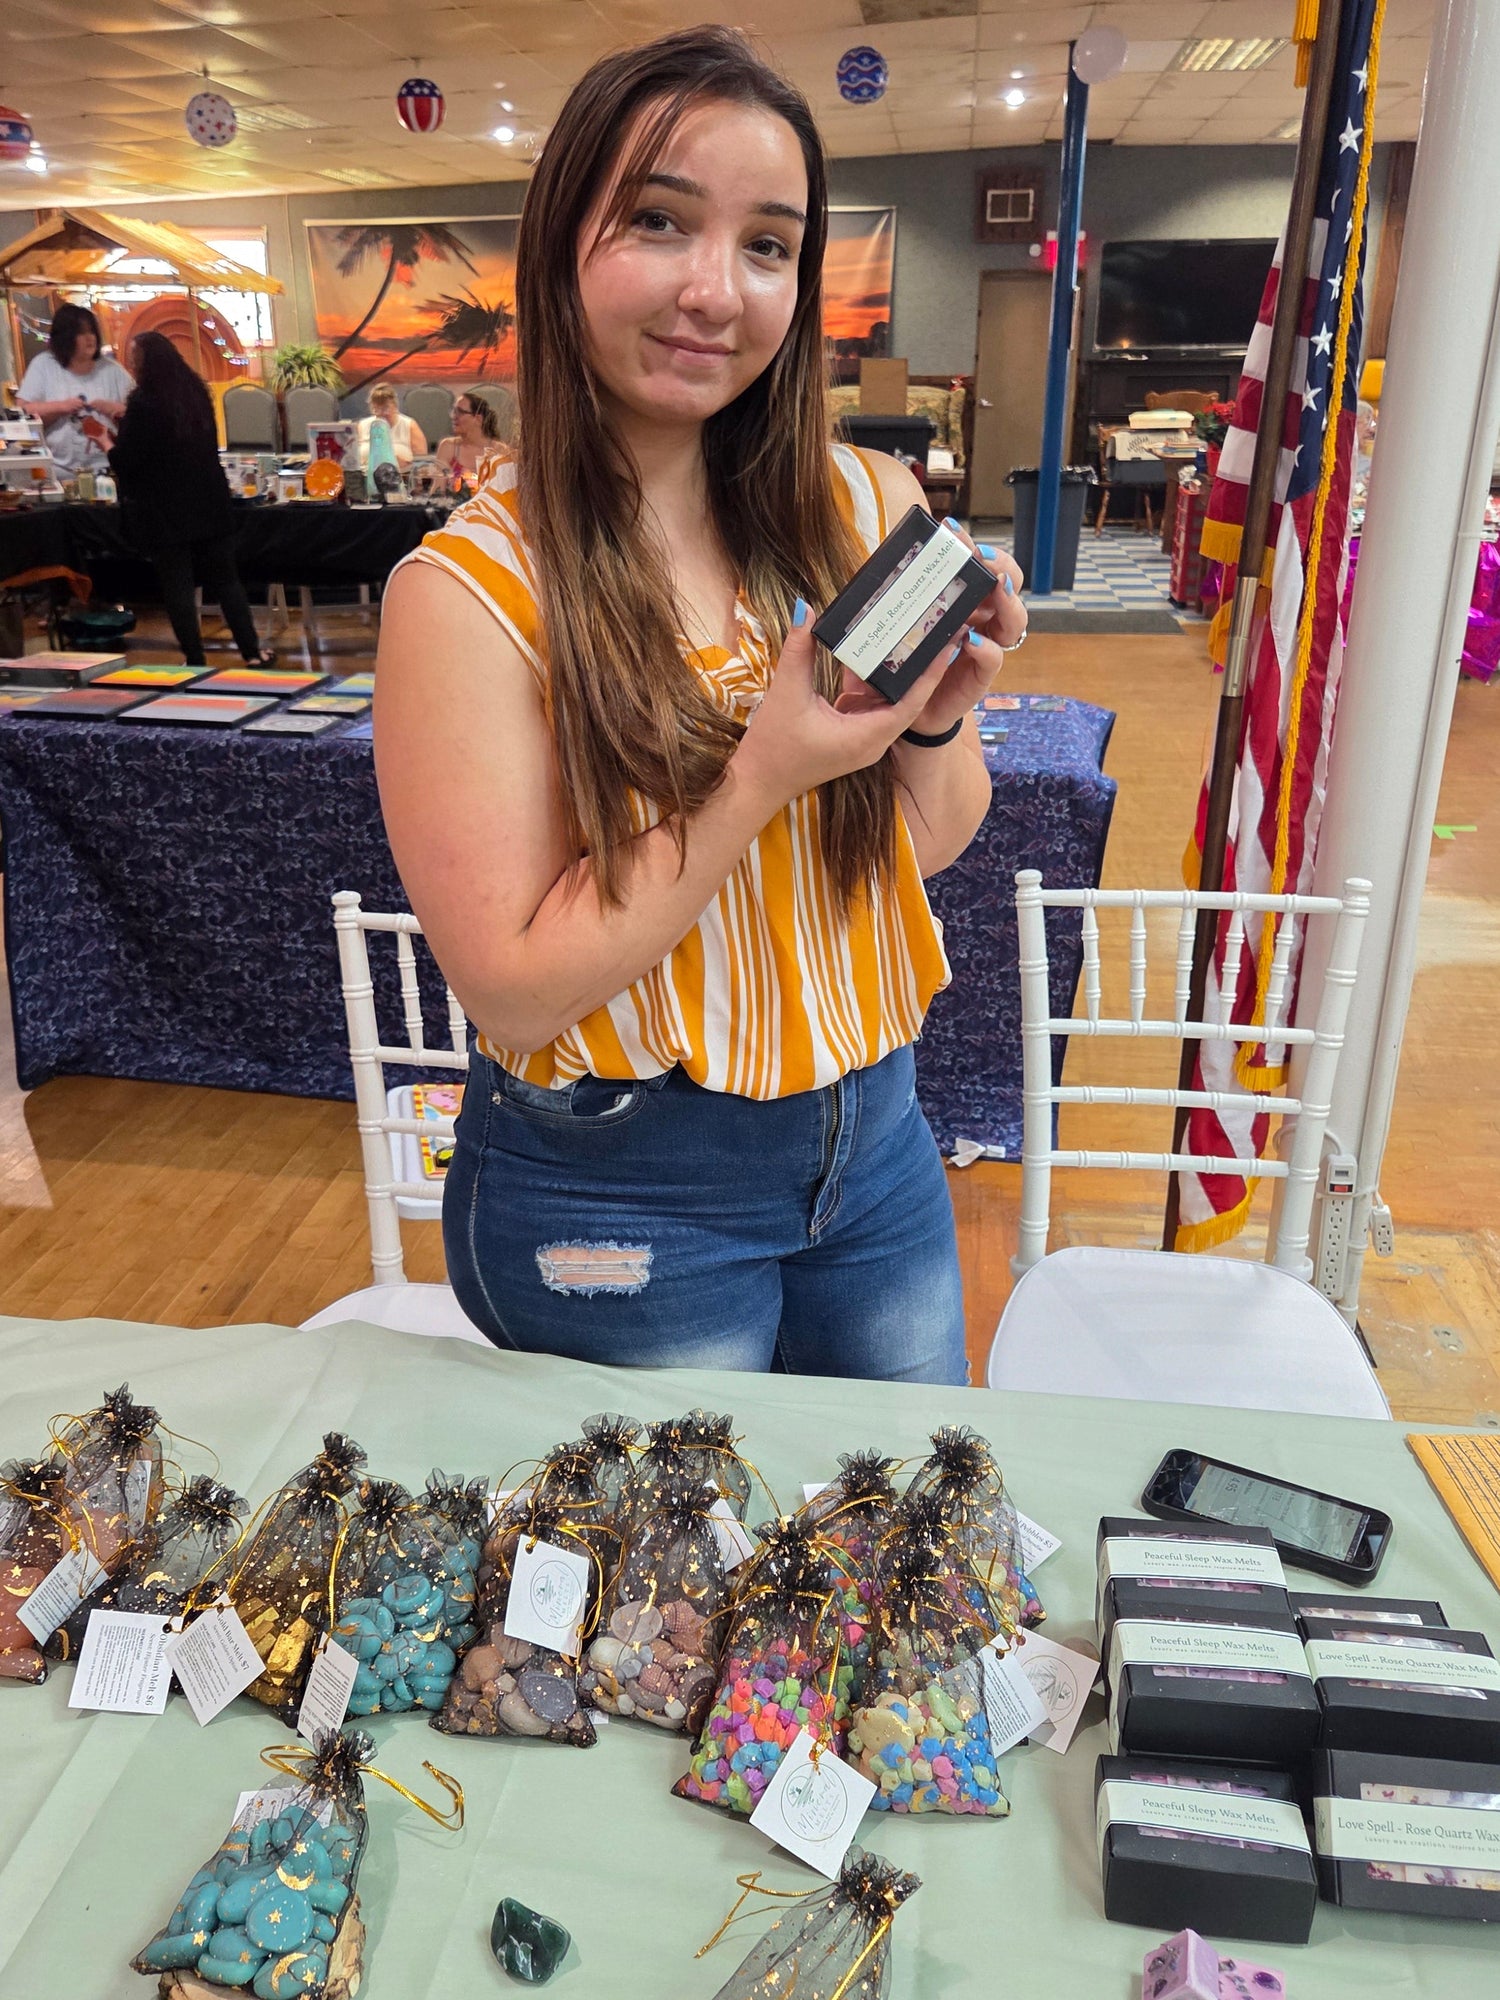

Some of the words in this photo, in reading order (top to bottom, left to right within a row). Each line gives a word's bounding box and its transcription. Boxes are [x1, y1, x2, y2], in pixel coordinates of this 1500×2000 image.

[852, 639, 870, 658] Love
[868, 618, 886, 640] Spell
[887, 600, 905, 618] Rose
[902, 574, 926, 600] Quartz
[923, 559, 940, 575] Wax
[938, 538, 956, 559] Melts
[1019, 1522, 1044, 1542] Pebbles
[1042, 1538, 1053, 1548] $5
[1144, 1552, 1182, 1560] Peaceful
[1185, 1554, 1210, 1563] Sleep
[1235, 1558, 1262, 1566] Melts
[215, 1613, 228, 1631] Gold
[224, 1630, 235, 1644] Bar
[231, 1643, 243, 1661] Melt
[1150, 1636, 1191, 1646] Peaceful
[1194, 1639, 1220, 1649] Sleep
[1222, 1641, 1244, 1650] Wax
[1247, 1643, 1275, 1652] Melts
[152, 1634, 167, 1671] Obsidian
[1319, 1652, 1342, 1660] Love
[1345, 1654, 1370, 1663] Spell
[1380, 1657, 1404, 1666] Rose
[1406, 1659, 1442, 1670] Quartz
[1443, 1662, 1466, 1671] Wax
[1469, 1666, 1498, 1676] Melts
[148, 1673, 158, 1691] Melt
[144, 1694, 154, 1706] $6
[1142, 1798, 1185, 1811] Peaceful
[1188, 1802, 1216, 1816] Sleep
[1219, 1808, 1242, 1820] Wax
[1246, 1812, 1276, 1824] Melts
[1338, 1817, 1364, 1830] Love
[1367, 1820, 1394, 1834] Spell
[1406, 1823, 1431, 1836] Rose
[1434, 1826, 1472, 1840] Quartz
[1475, 1828, 1500, 1842] Wax
